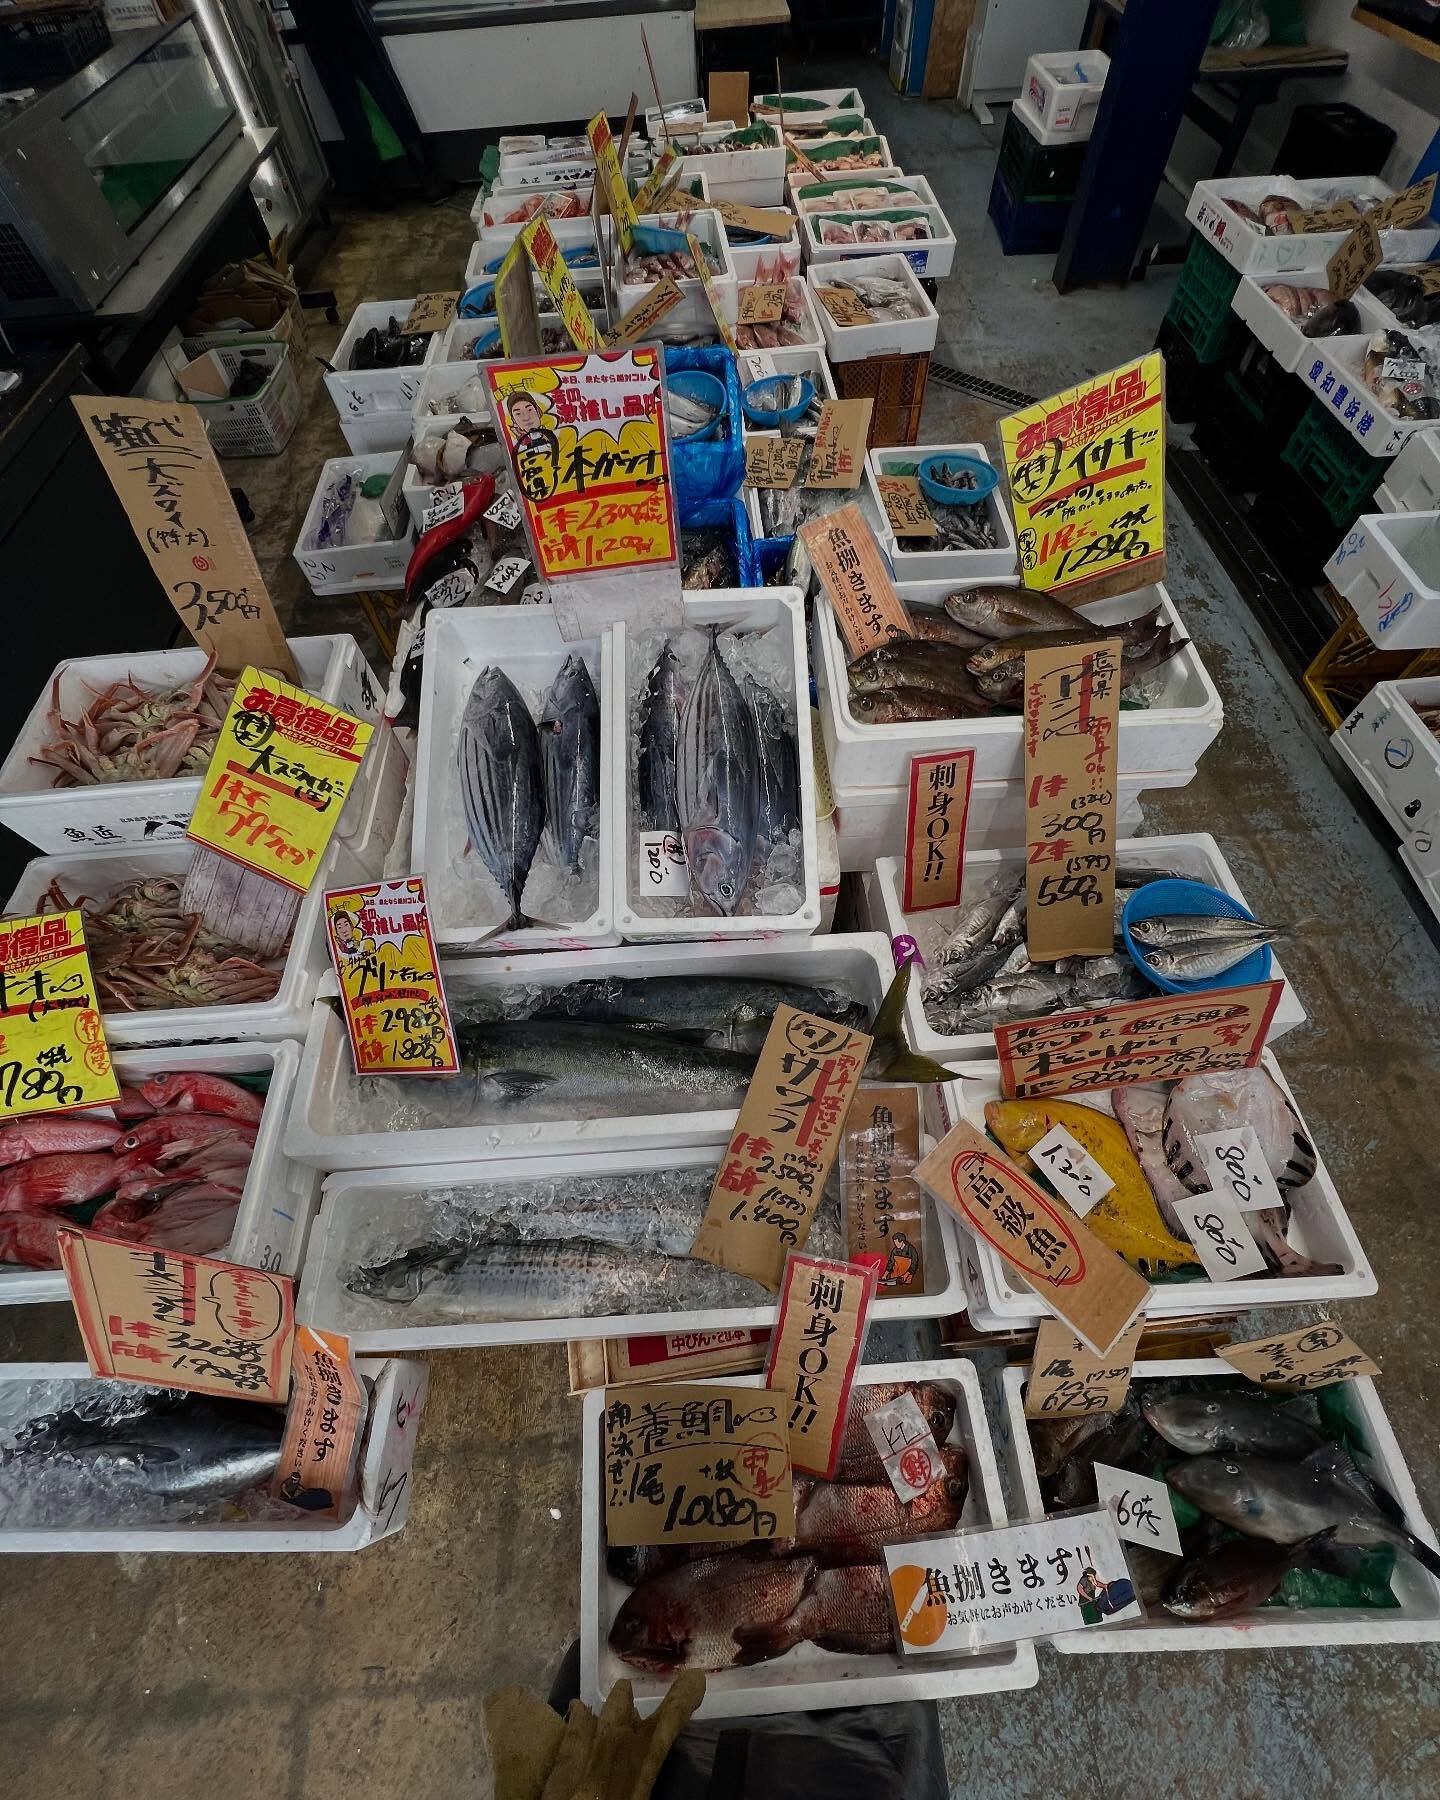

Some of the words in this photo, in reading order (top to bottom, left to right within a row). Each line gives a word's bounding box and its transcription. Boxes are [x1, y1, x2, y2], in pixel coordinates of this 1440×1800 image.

[826, 527, 884, 638] 魚捌きます
[922, 761, 958, 884] 刺身OK!!
[787, 1272, 846, 1435] 刺身OK!!
